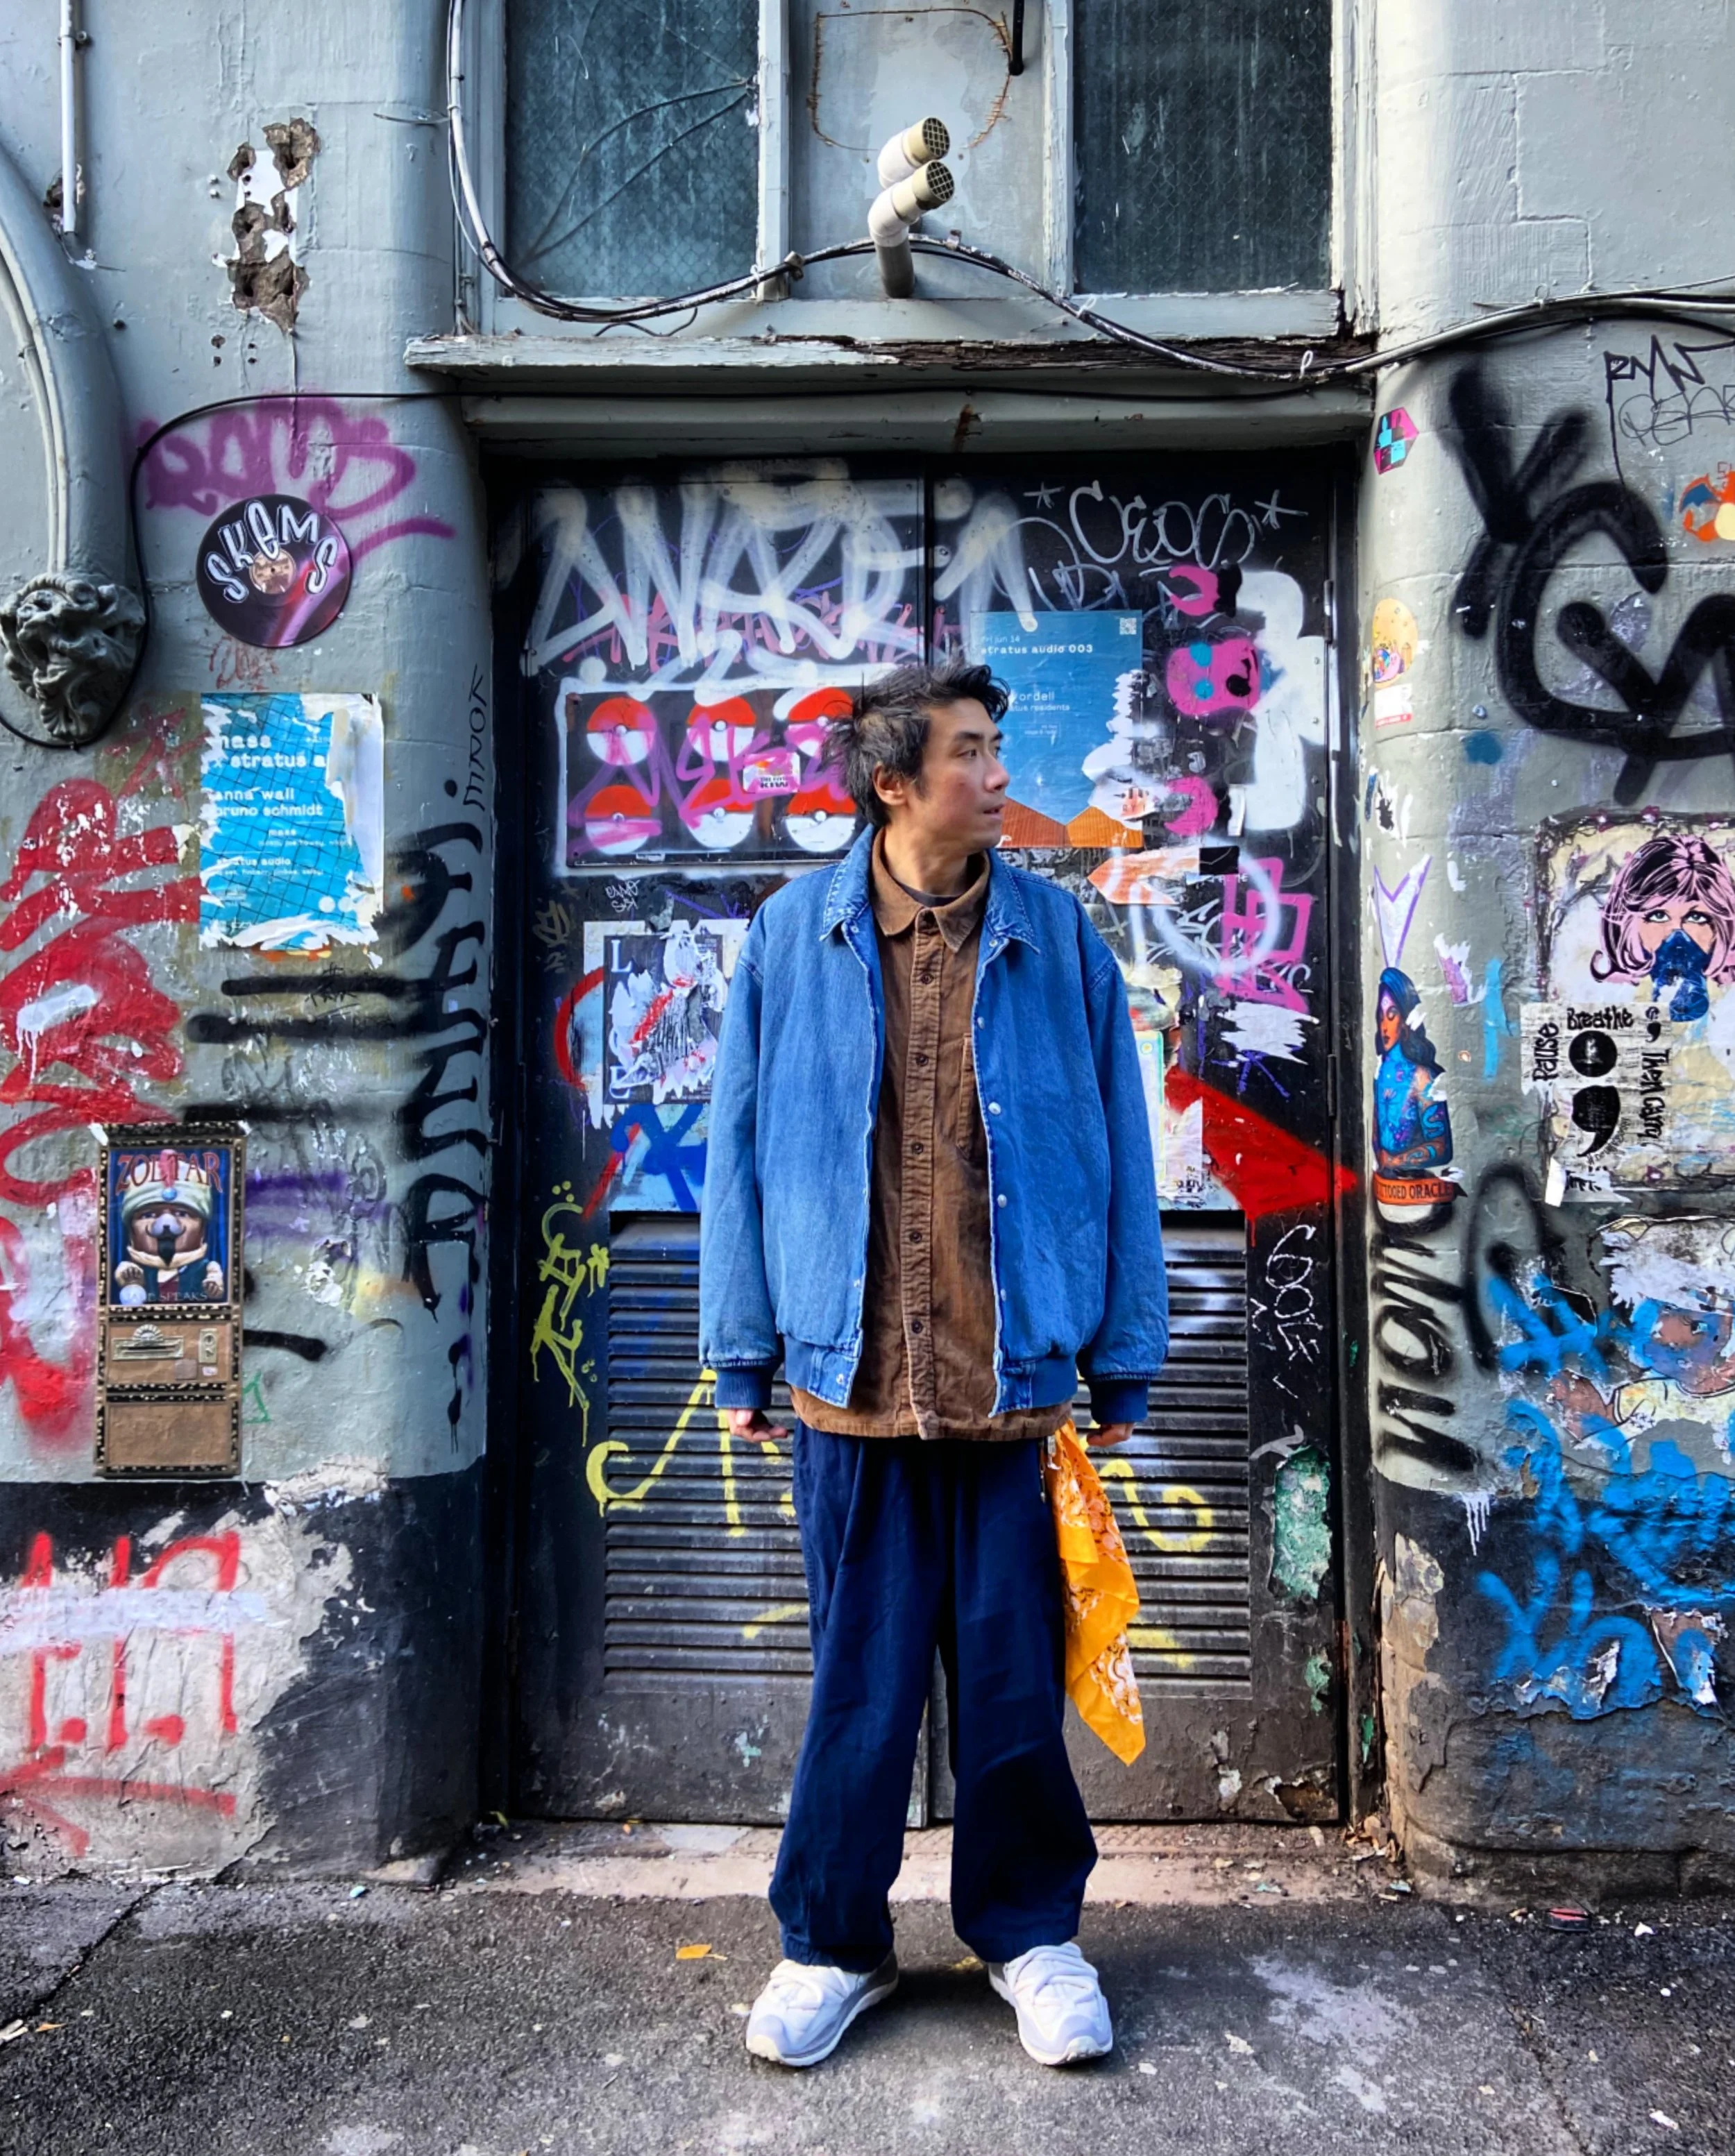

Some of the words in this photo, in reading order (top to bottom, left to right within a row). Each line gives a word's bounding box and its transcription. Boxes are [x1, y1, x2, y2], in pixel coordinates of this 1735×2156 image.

[981, 644, 1027, 654] stratus
[1031, 644, 1065, 654] audio
[1068, 644, 1094, 654] 003
[1030, 702, 1070, 712] residents
[230, 752, 307, 768] stratus
[261, 788, 294, 801] wall
[262, 804, 323, 816] schmidt
[1566, 1005, 1634, 1030] Breathe
[1532, 1022, 1559, 1081] Pause
[115, 1151, 223, 1196] ZOLTAR
[1409, 1182, 1455, 1199] ORACLE
